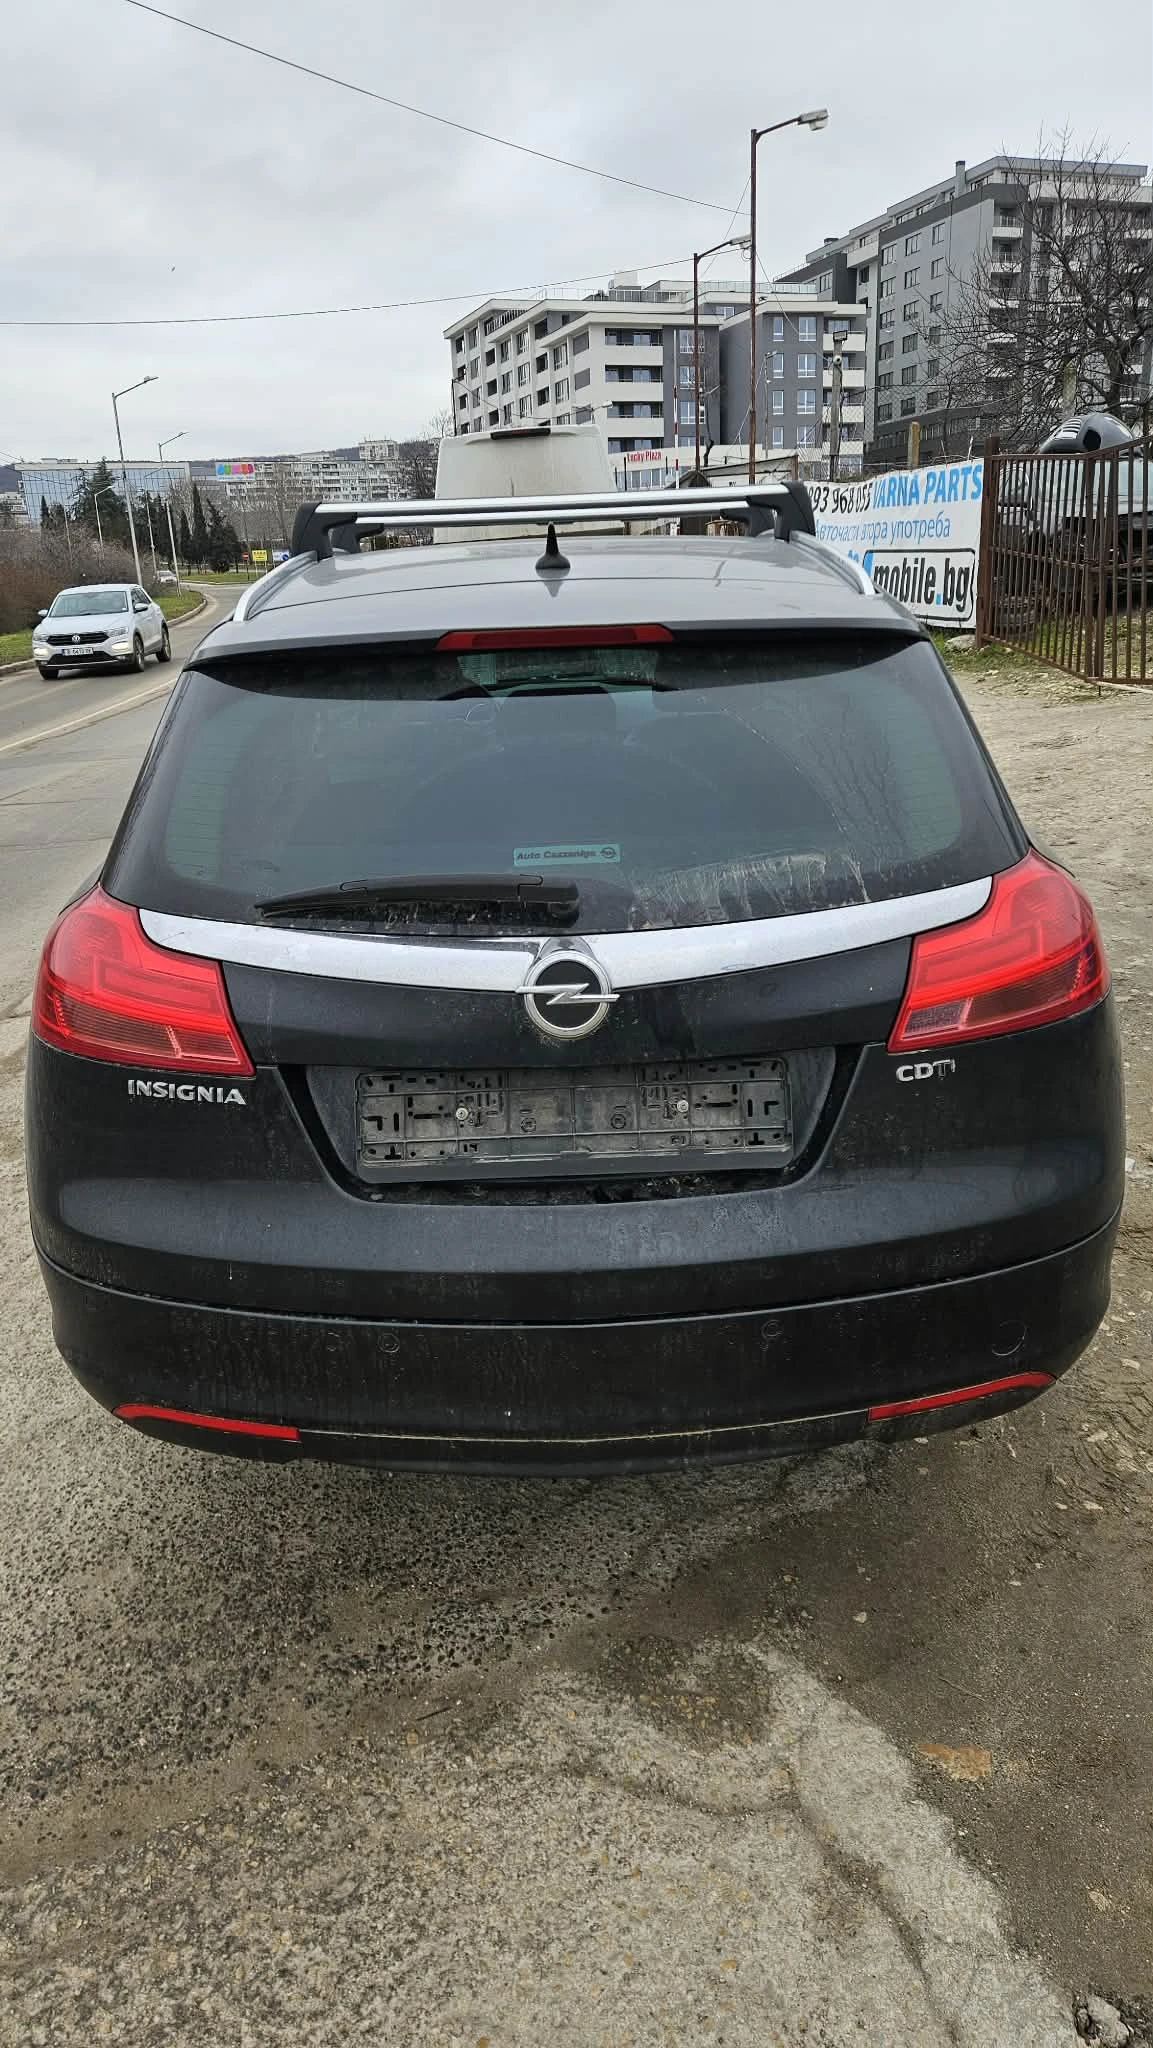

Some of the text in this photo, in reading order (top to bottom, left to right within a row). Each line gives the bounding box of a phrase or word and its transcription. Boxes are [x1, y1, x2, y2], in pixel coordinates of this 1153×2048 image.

[646, 449, 661, 461] Plaza
[832, 487, 854, 514] 968
[856, 482, 874, 513] 055
[873, 474, 920, 509] VARNA
[924, 464, 984, 504] PARTS
[890, 511, 951, 545] употреба
[874, 557, 970, 612] mobile.bg
[517, 851, 541, 860] Auto
[127, 1079, 247, 1105] INSIGNIA
